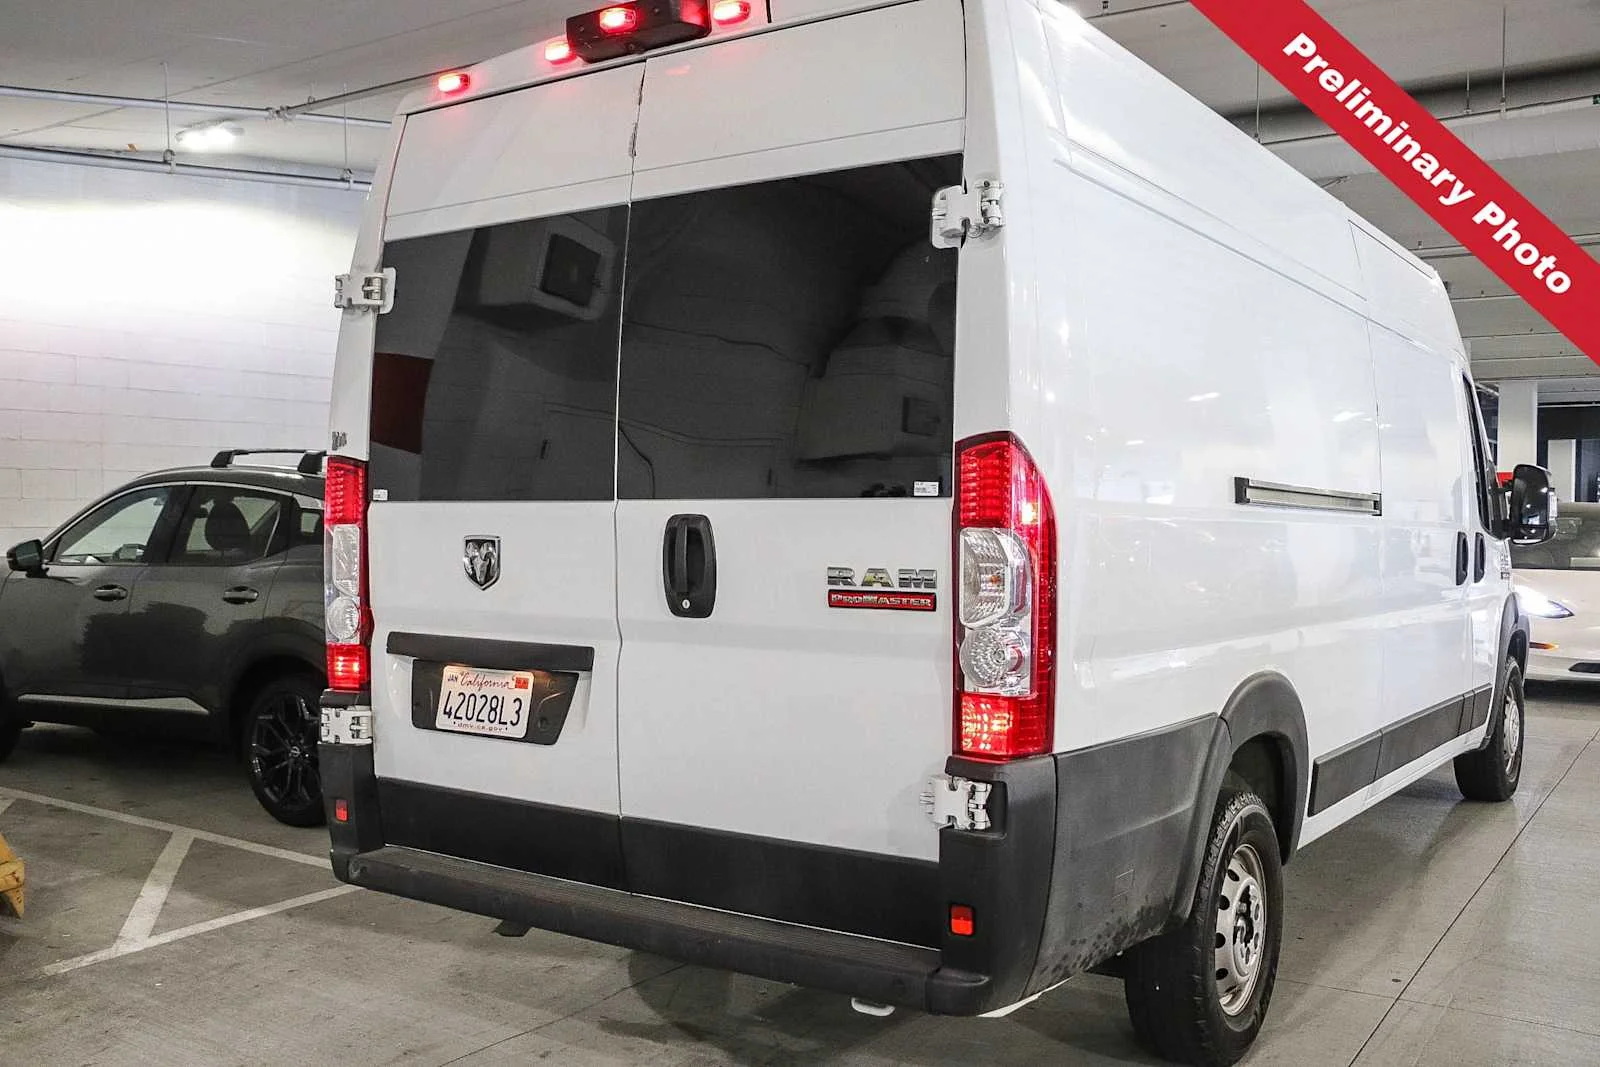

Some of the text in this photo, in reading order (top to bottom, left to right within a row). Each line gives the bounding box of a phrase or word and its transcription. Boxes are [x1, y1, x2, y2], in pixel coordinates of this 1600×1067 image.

[827, 566, 937, 588] RAM
[460, 671, 511, 691] California
[443, 690, 523, 727] 42028L3
